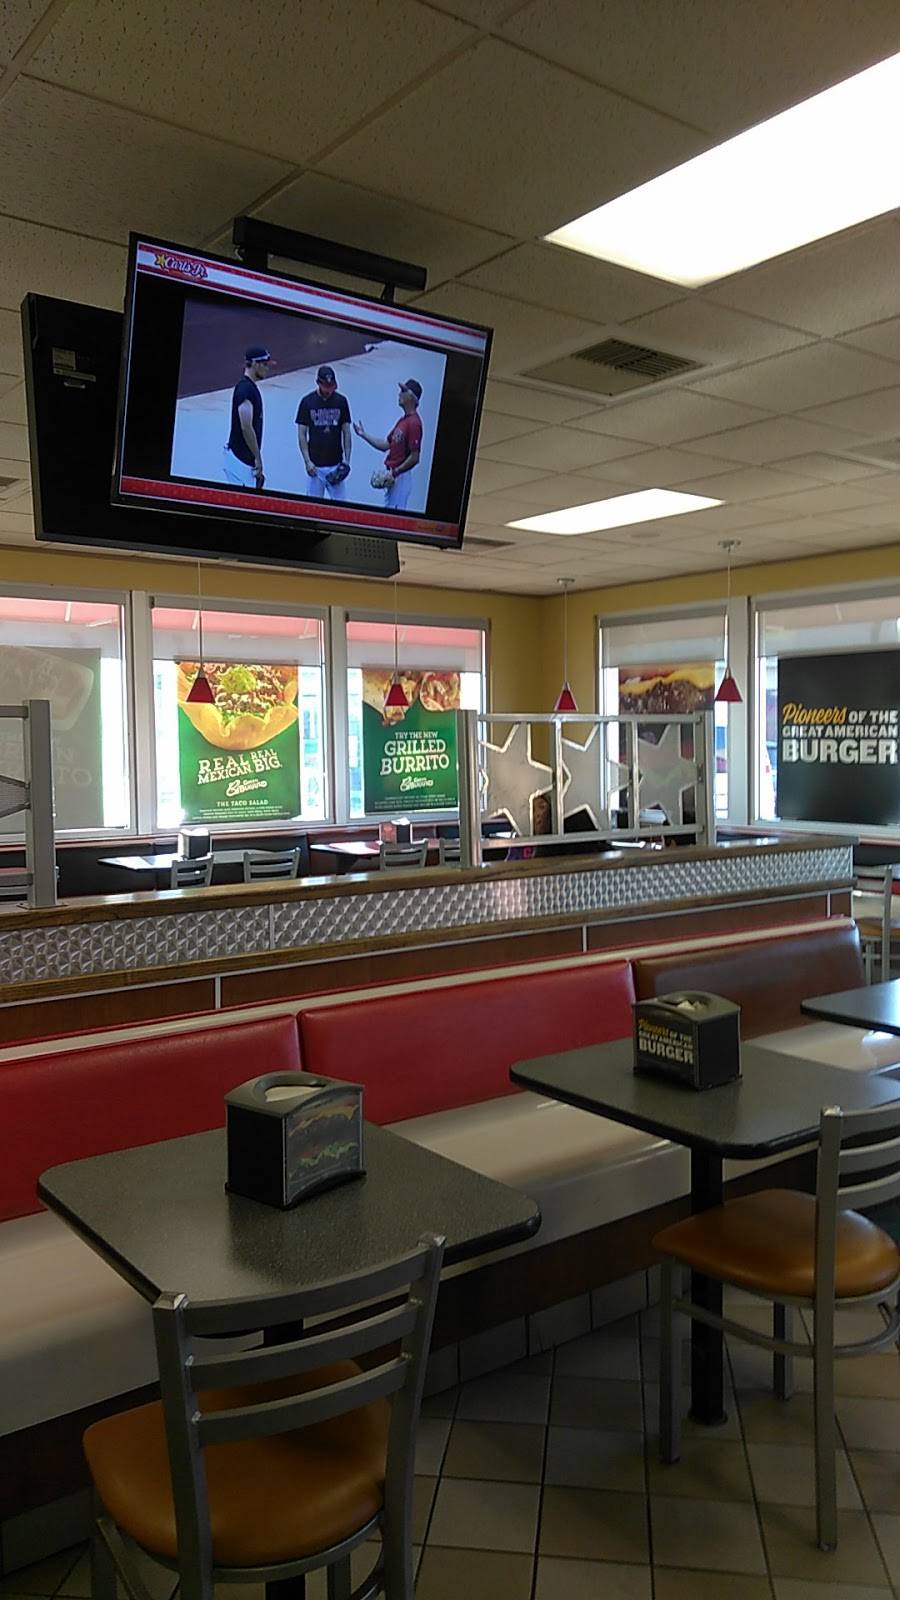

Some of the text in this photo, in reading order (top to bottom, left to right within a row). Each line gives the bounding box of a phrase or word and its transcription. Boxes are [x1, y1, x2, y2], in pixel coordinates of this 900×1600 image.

[782, 703, 899, 725] Pioneers OF THE
[395, 731, 439, 740] TRY THE NEW
[782, 724, 899, 738] GREAT AMERICAN
[250, 748, 277, 761] REAL
[384, 739, 446, 756] GRILLED
[782, 738, 899, 765] BURGER
[198, 753, 250, 775] REAL
[379, 753, 450, 775] BURRITO
[638, 1038, 693, 1065] BURGER
